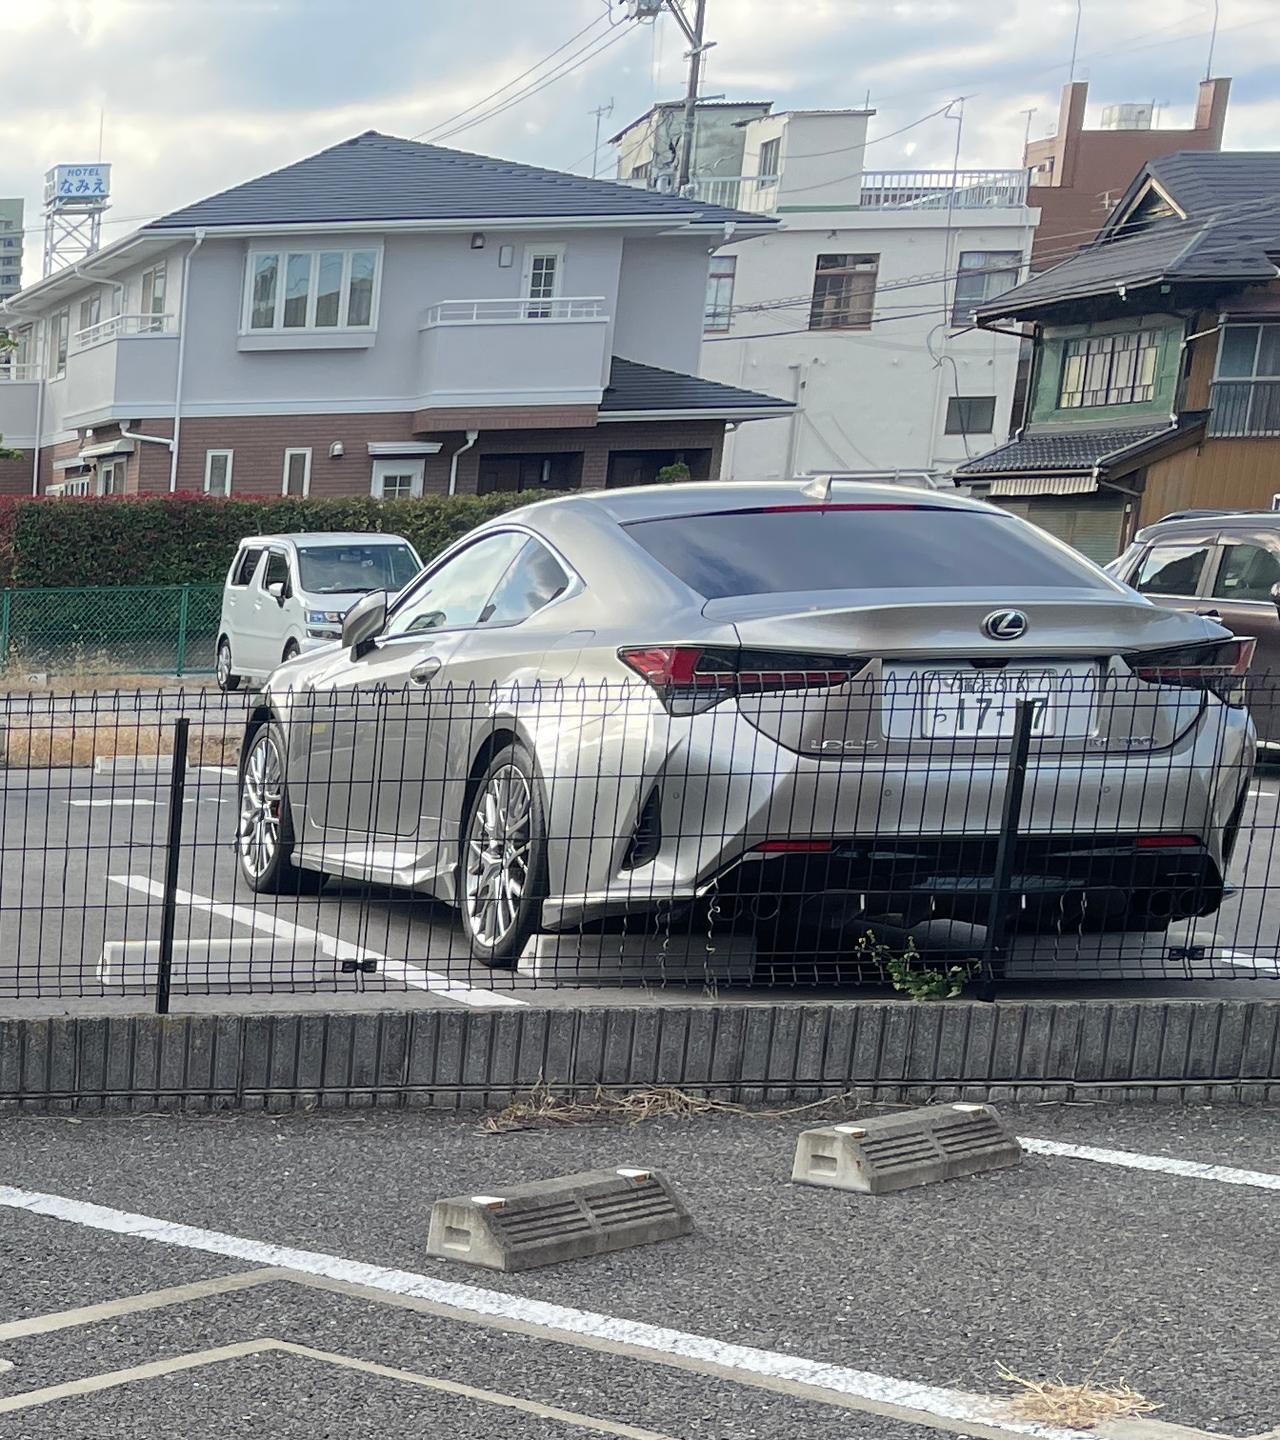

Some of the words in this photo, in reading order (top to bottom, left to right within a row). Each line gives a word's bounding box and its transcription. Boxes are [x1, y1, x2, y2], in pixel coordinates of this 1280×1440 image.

[67, 168, 100, 177] HOTEL
[60, 178, 106, 194] なみえ
